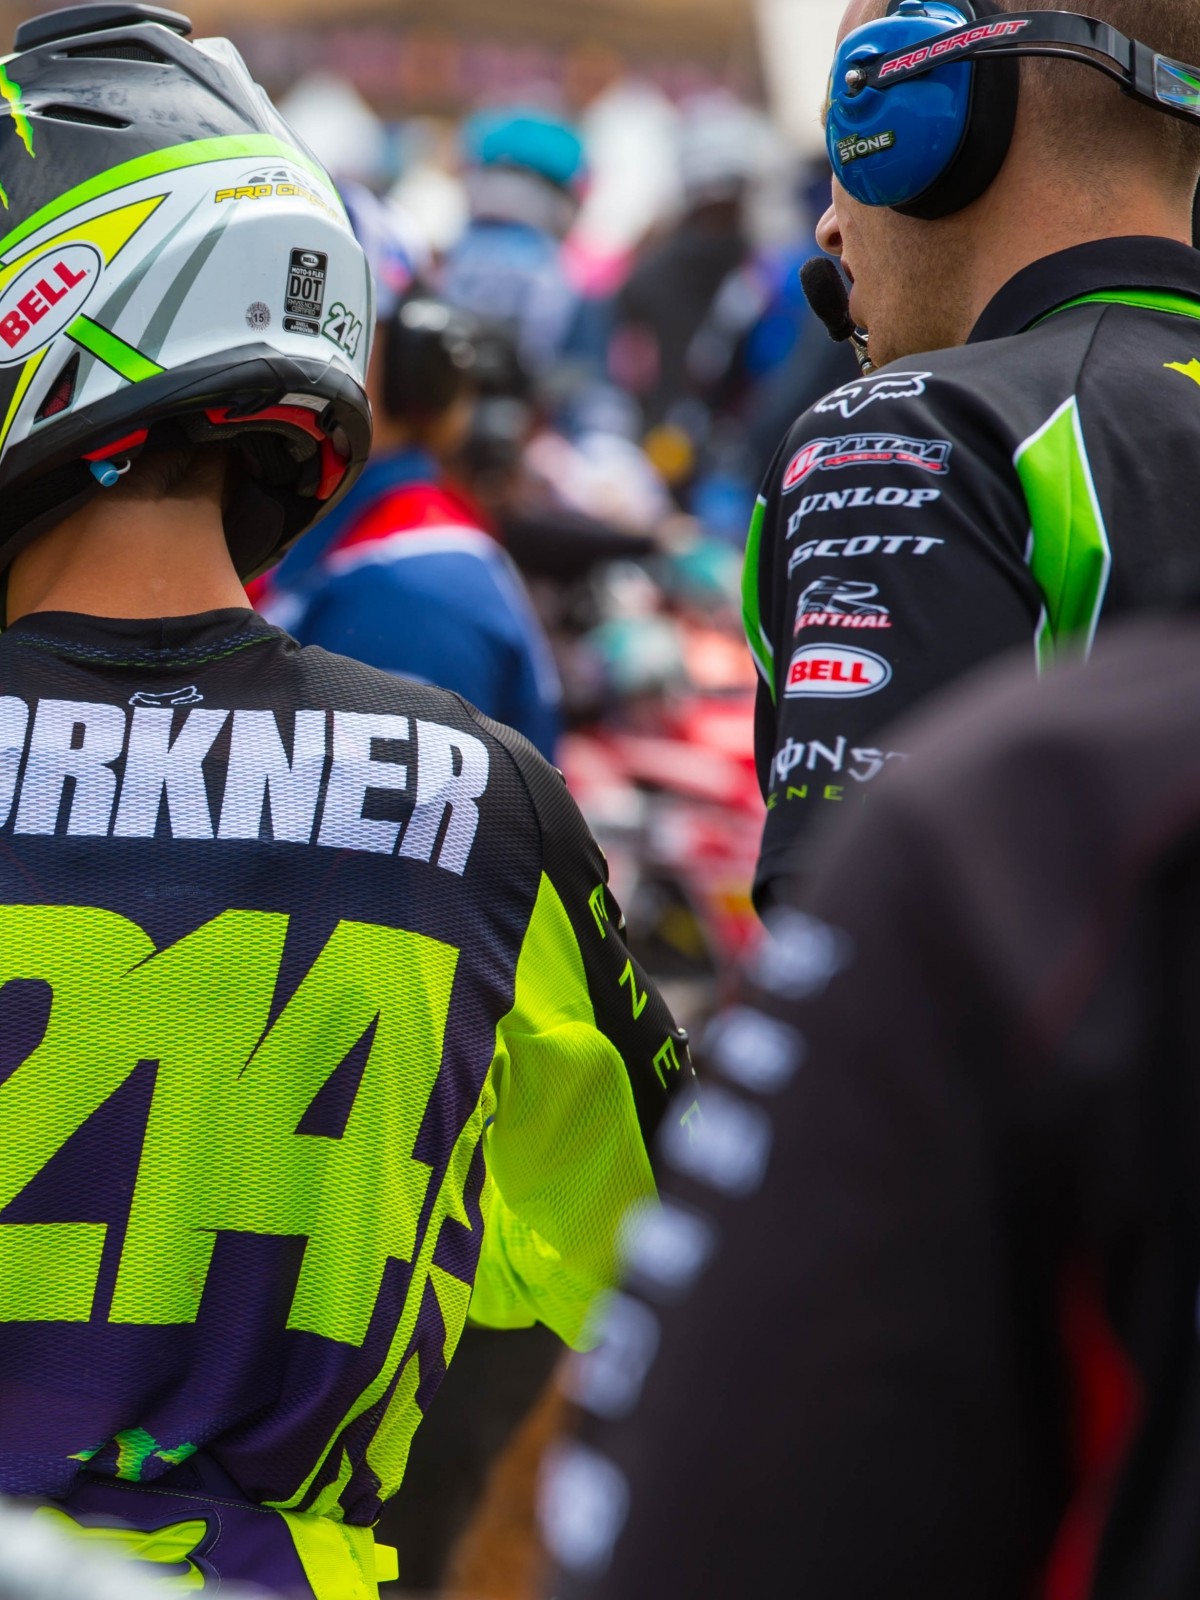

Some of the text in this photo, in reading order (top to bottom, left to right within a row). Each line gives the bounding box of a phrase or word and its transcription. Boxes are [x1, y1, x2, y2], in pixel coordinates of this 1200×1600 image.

[878, 19, 1030, 79] PRO CIRCUIT
[841, 132, 891, 161] STONE
[214, 184, 273, 204] PRO
[289, 275, 322, 302] DOT
[254, 313, 264, 323] 15
[321, 301, 363, 360] 214
[785, 487, 941, 540] DUNLOP
[788, 535, 946, 579] SCOTT
[790, 660, 871, 685] BELL
[769, 735, 908, 791] ONS
